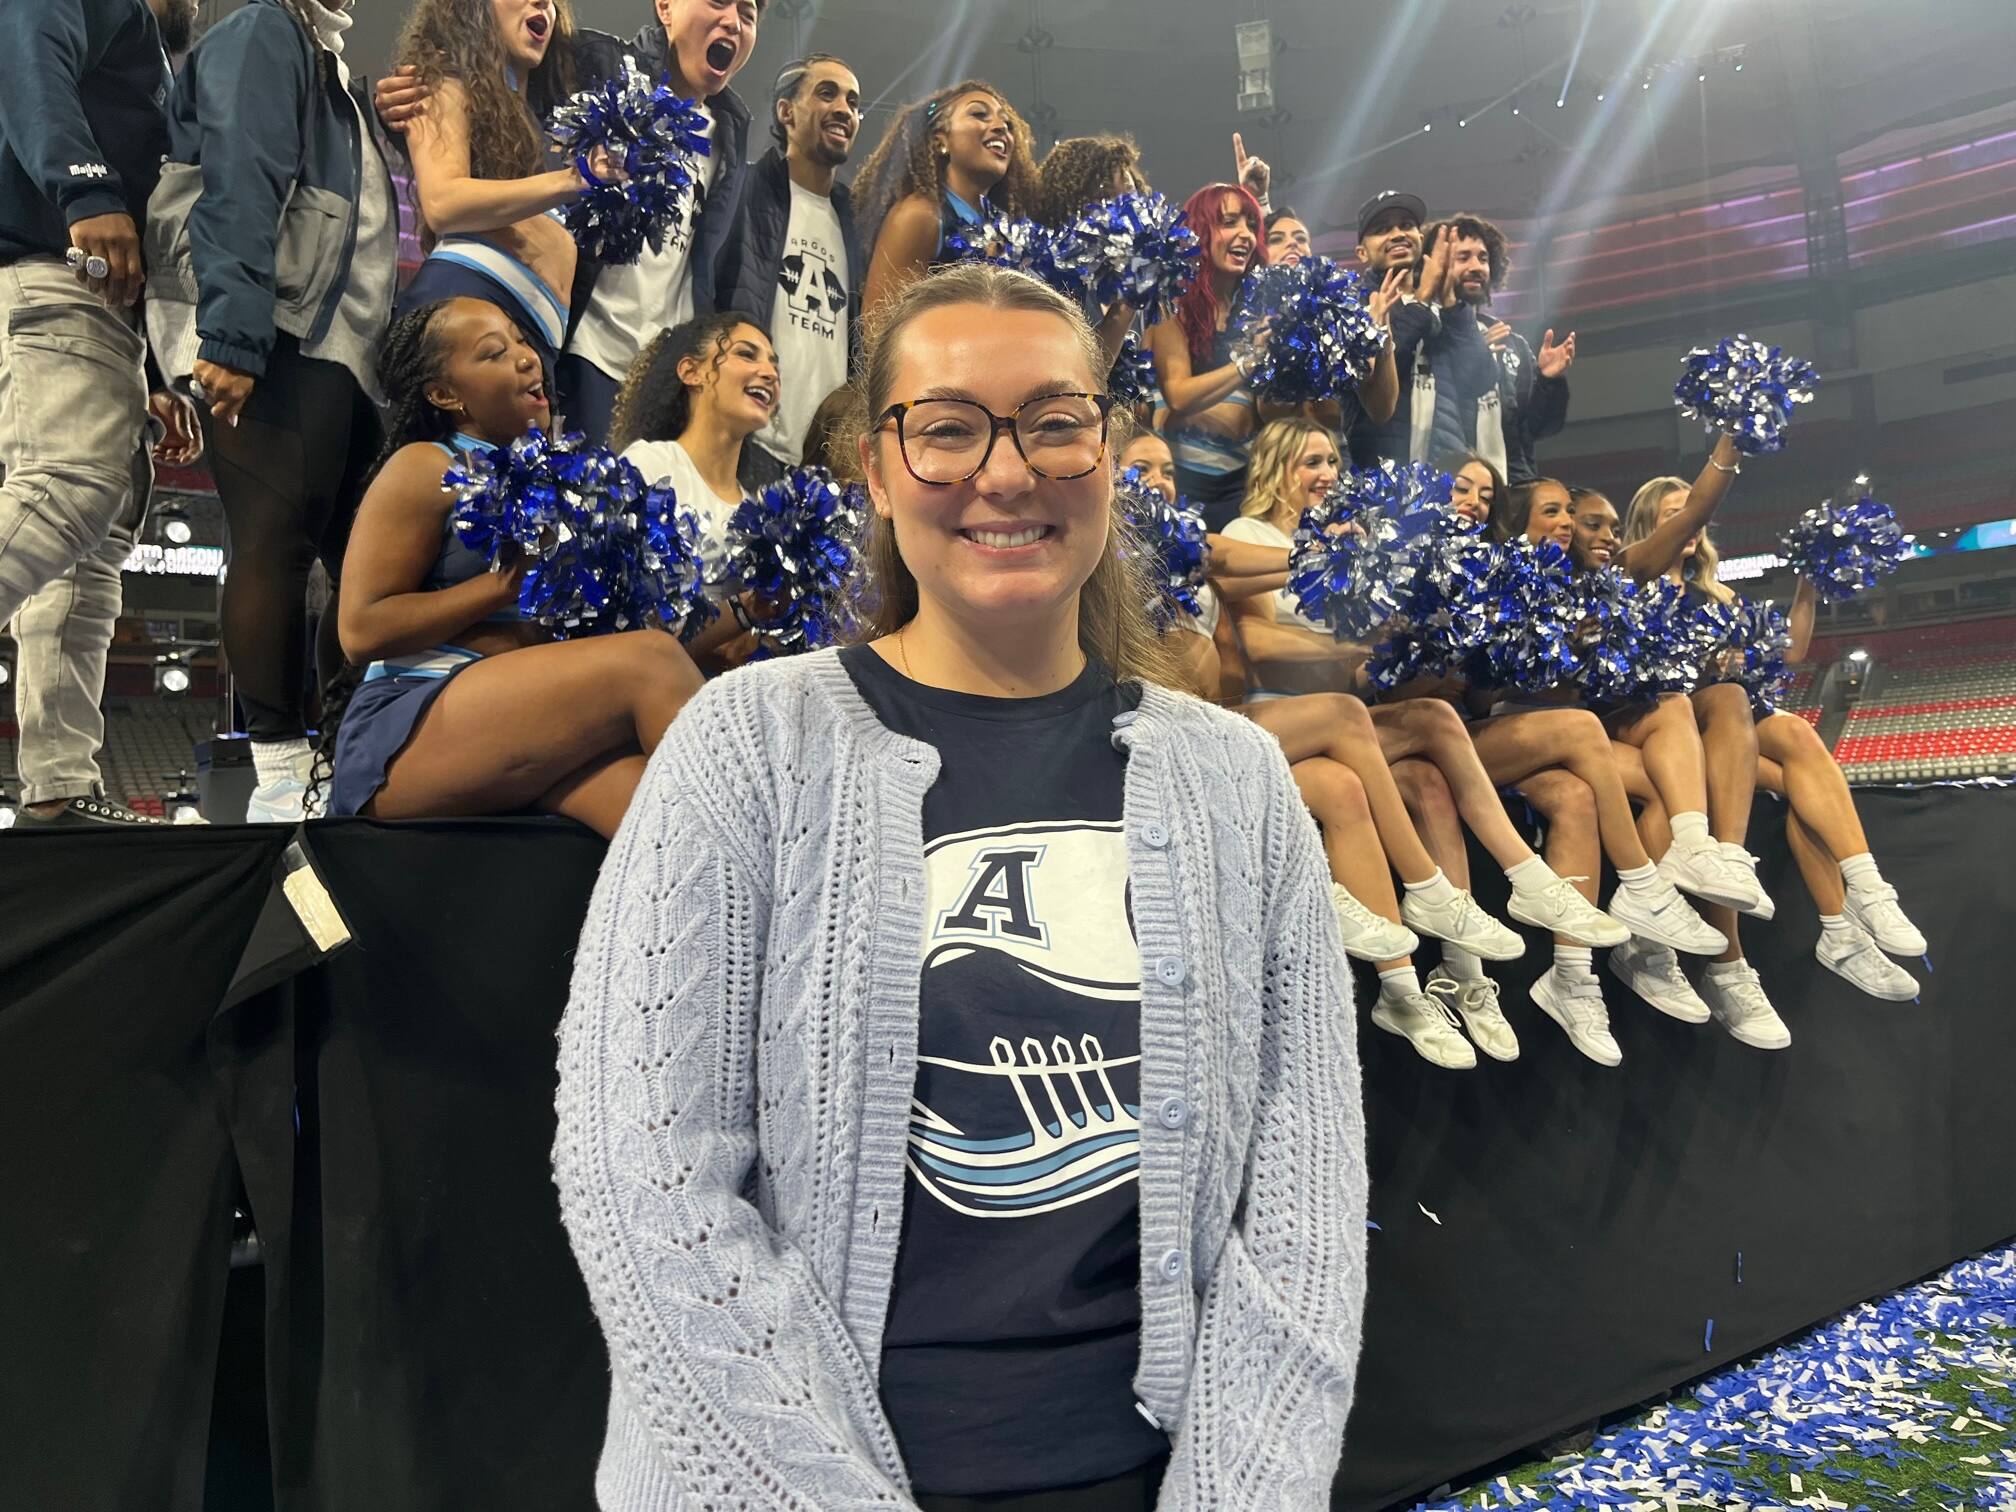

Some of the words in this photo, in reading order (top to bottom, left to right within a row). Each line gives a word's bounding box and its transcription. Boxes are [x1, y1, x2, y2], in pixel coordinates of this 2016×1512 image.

[791, 238, 836, 262] ARGOS
[788, 312, 834, 340] TEAM
[932, 844, 1051, 951] A
